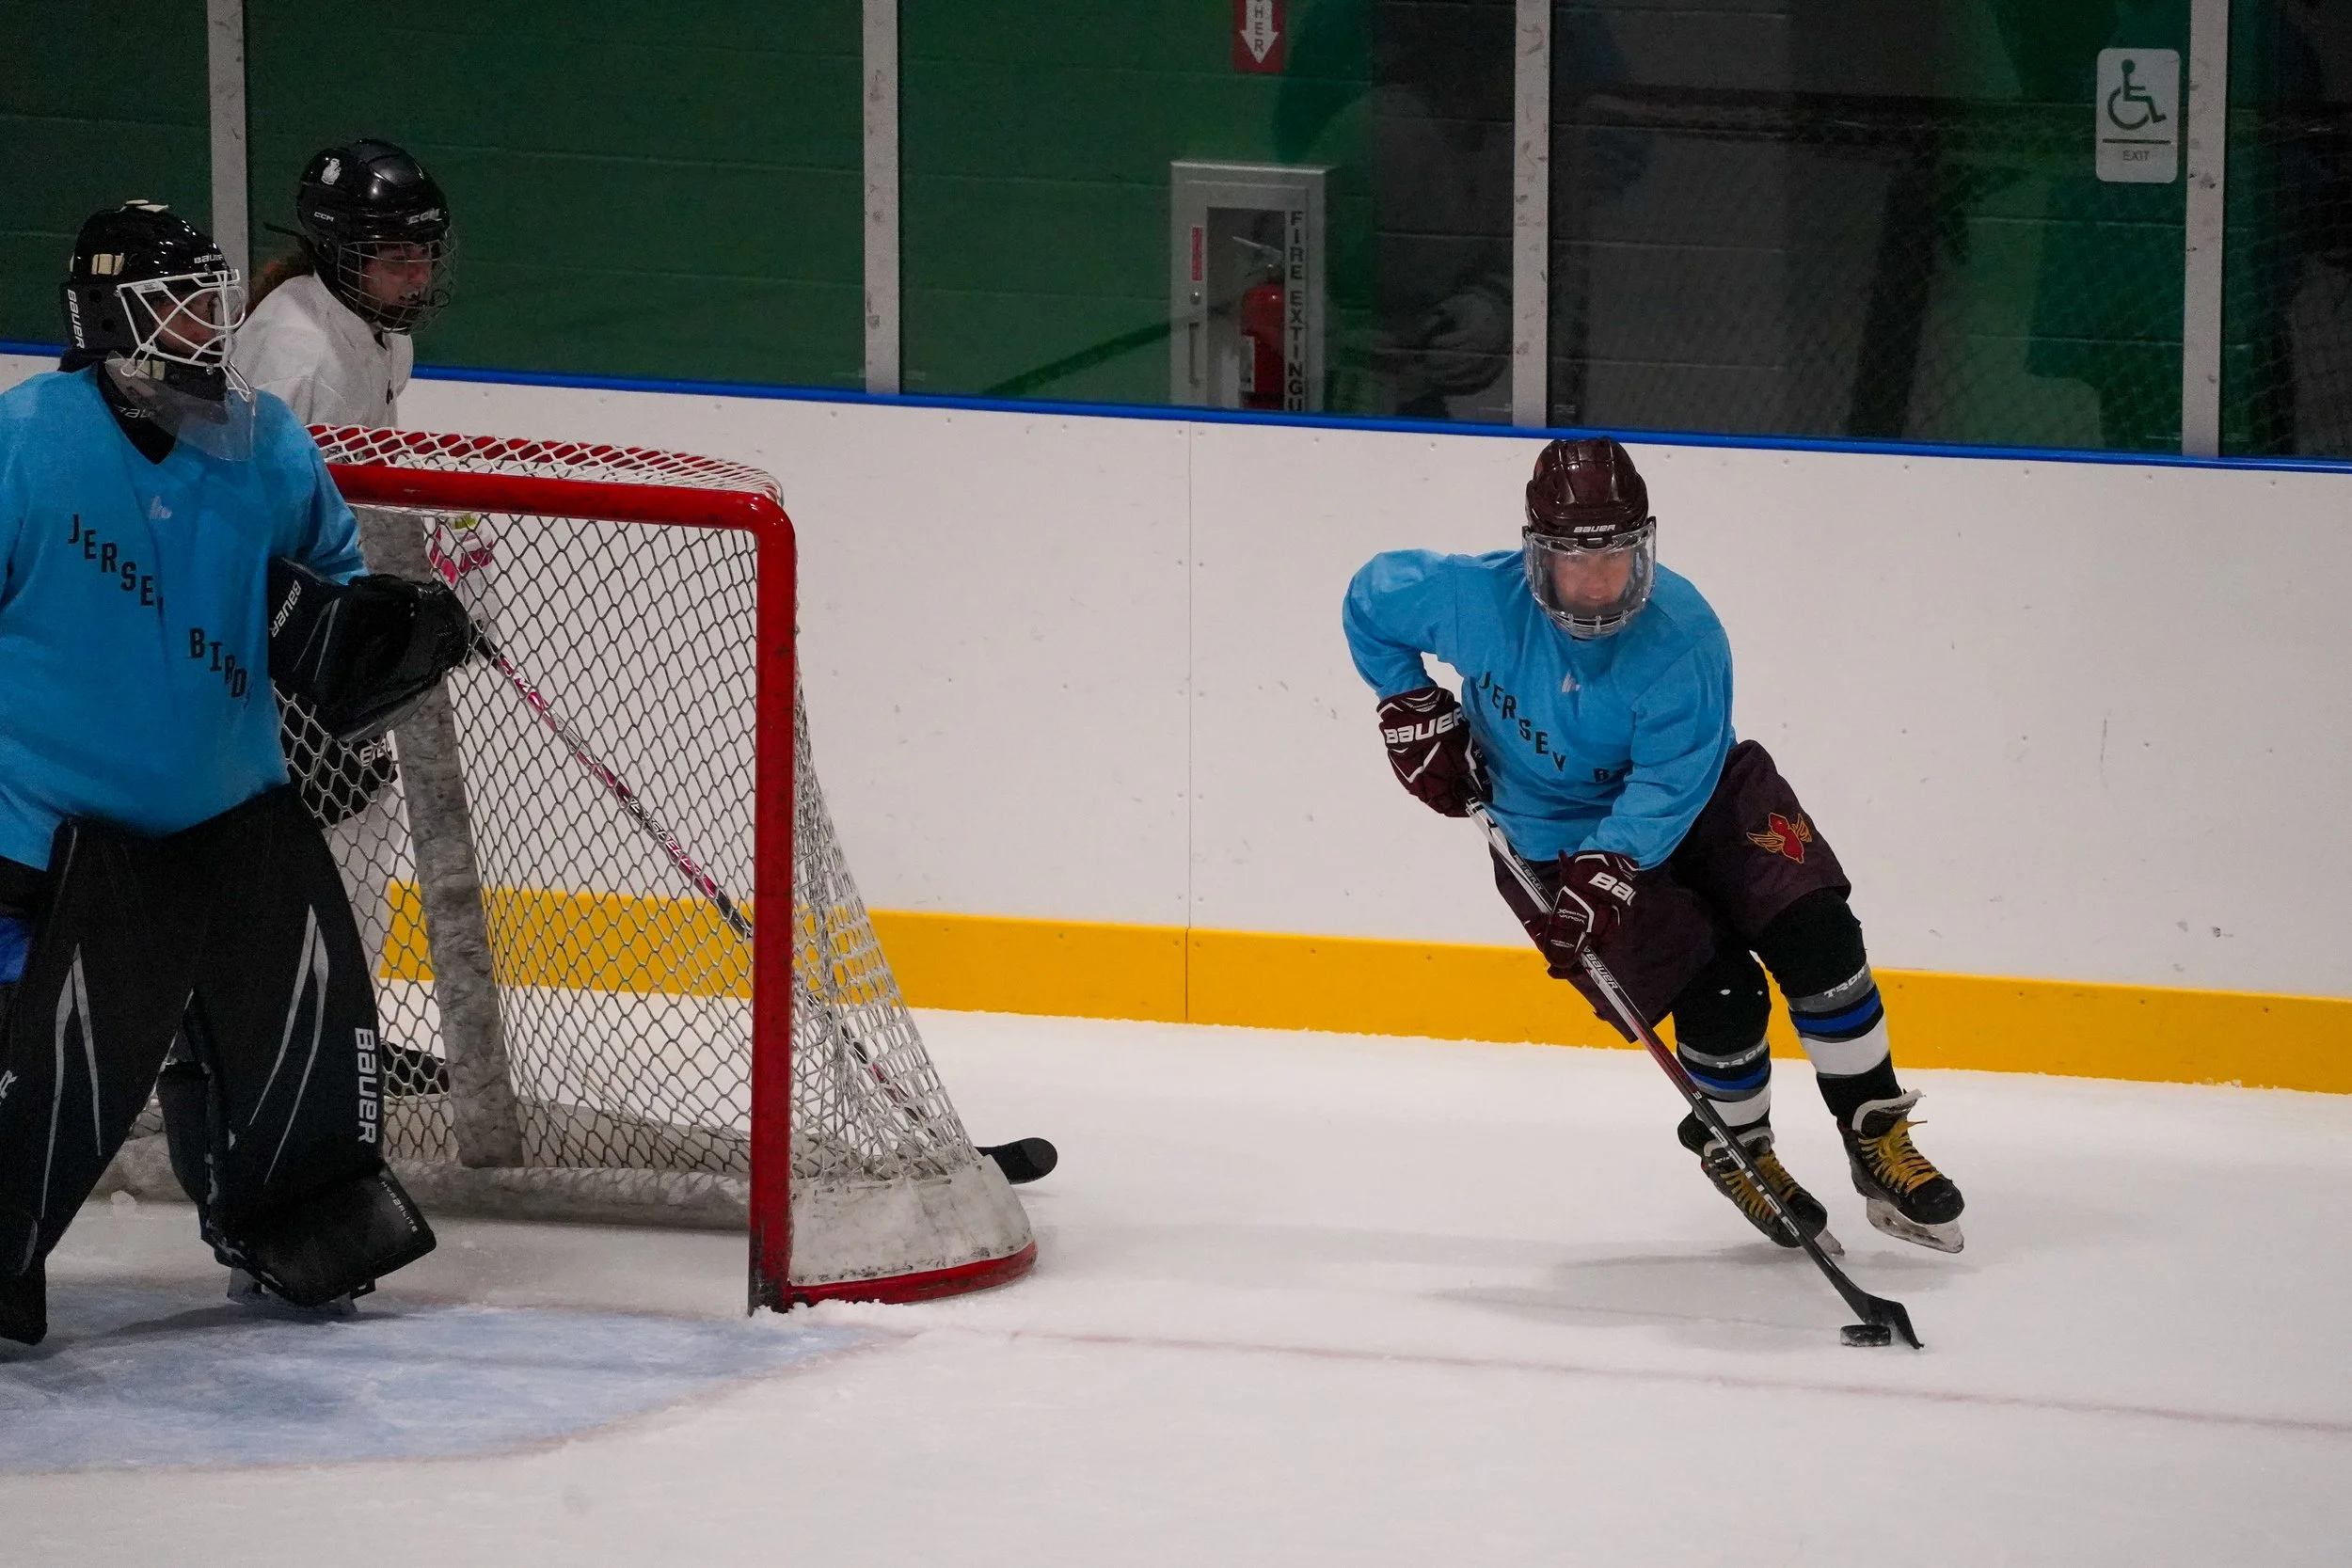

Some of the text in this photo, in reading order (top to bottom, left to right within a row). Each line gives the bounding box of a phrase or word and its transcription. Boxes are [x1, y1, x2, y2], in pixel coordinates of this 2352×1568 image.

[1253, 0, 1264, 53] HER
[2122, 150, 2151, 162] EXIT
[313, 211, 335, 222] CCM
[1290, 211, 1304, 280] FIRE
[68, 289, 86, 349] BAUER
[1573, 524, 1616, 533] BAUER
[270, 579, 302, 638] BAUER
[1585, 953, 1619, 989] BAUER
[355, 1027, 377, 1144] BAUER
